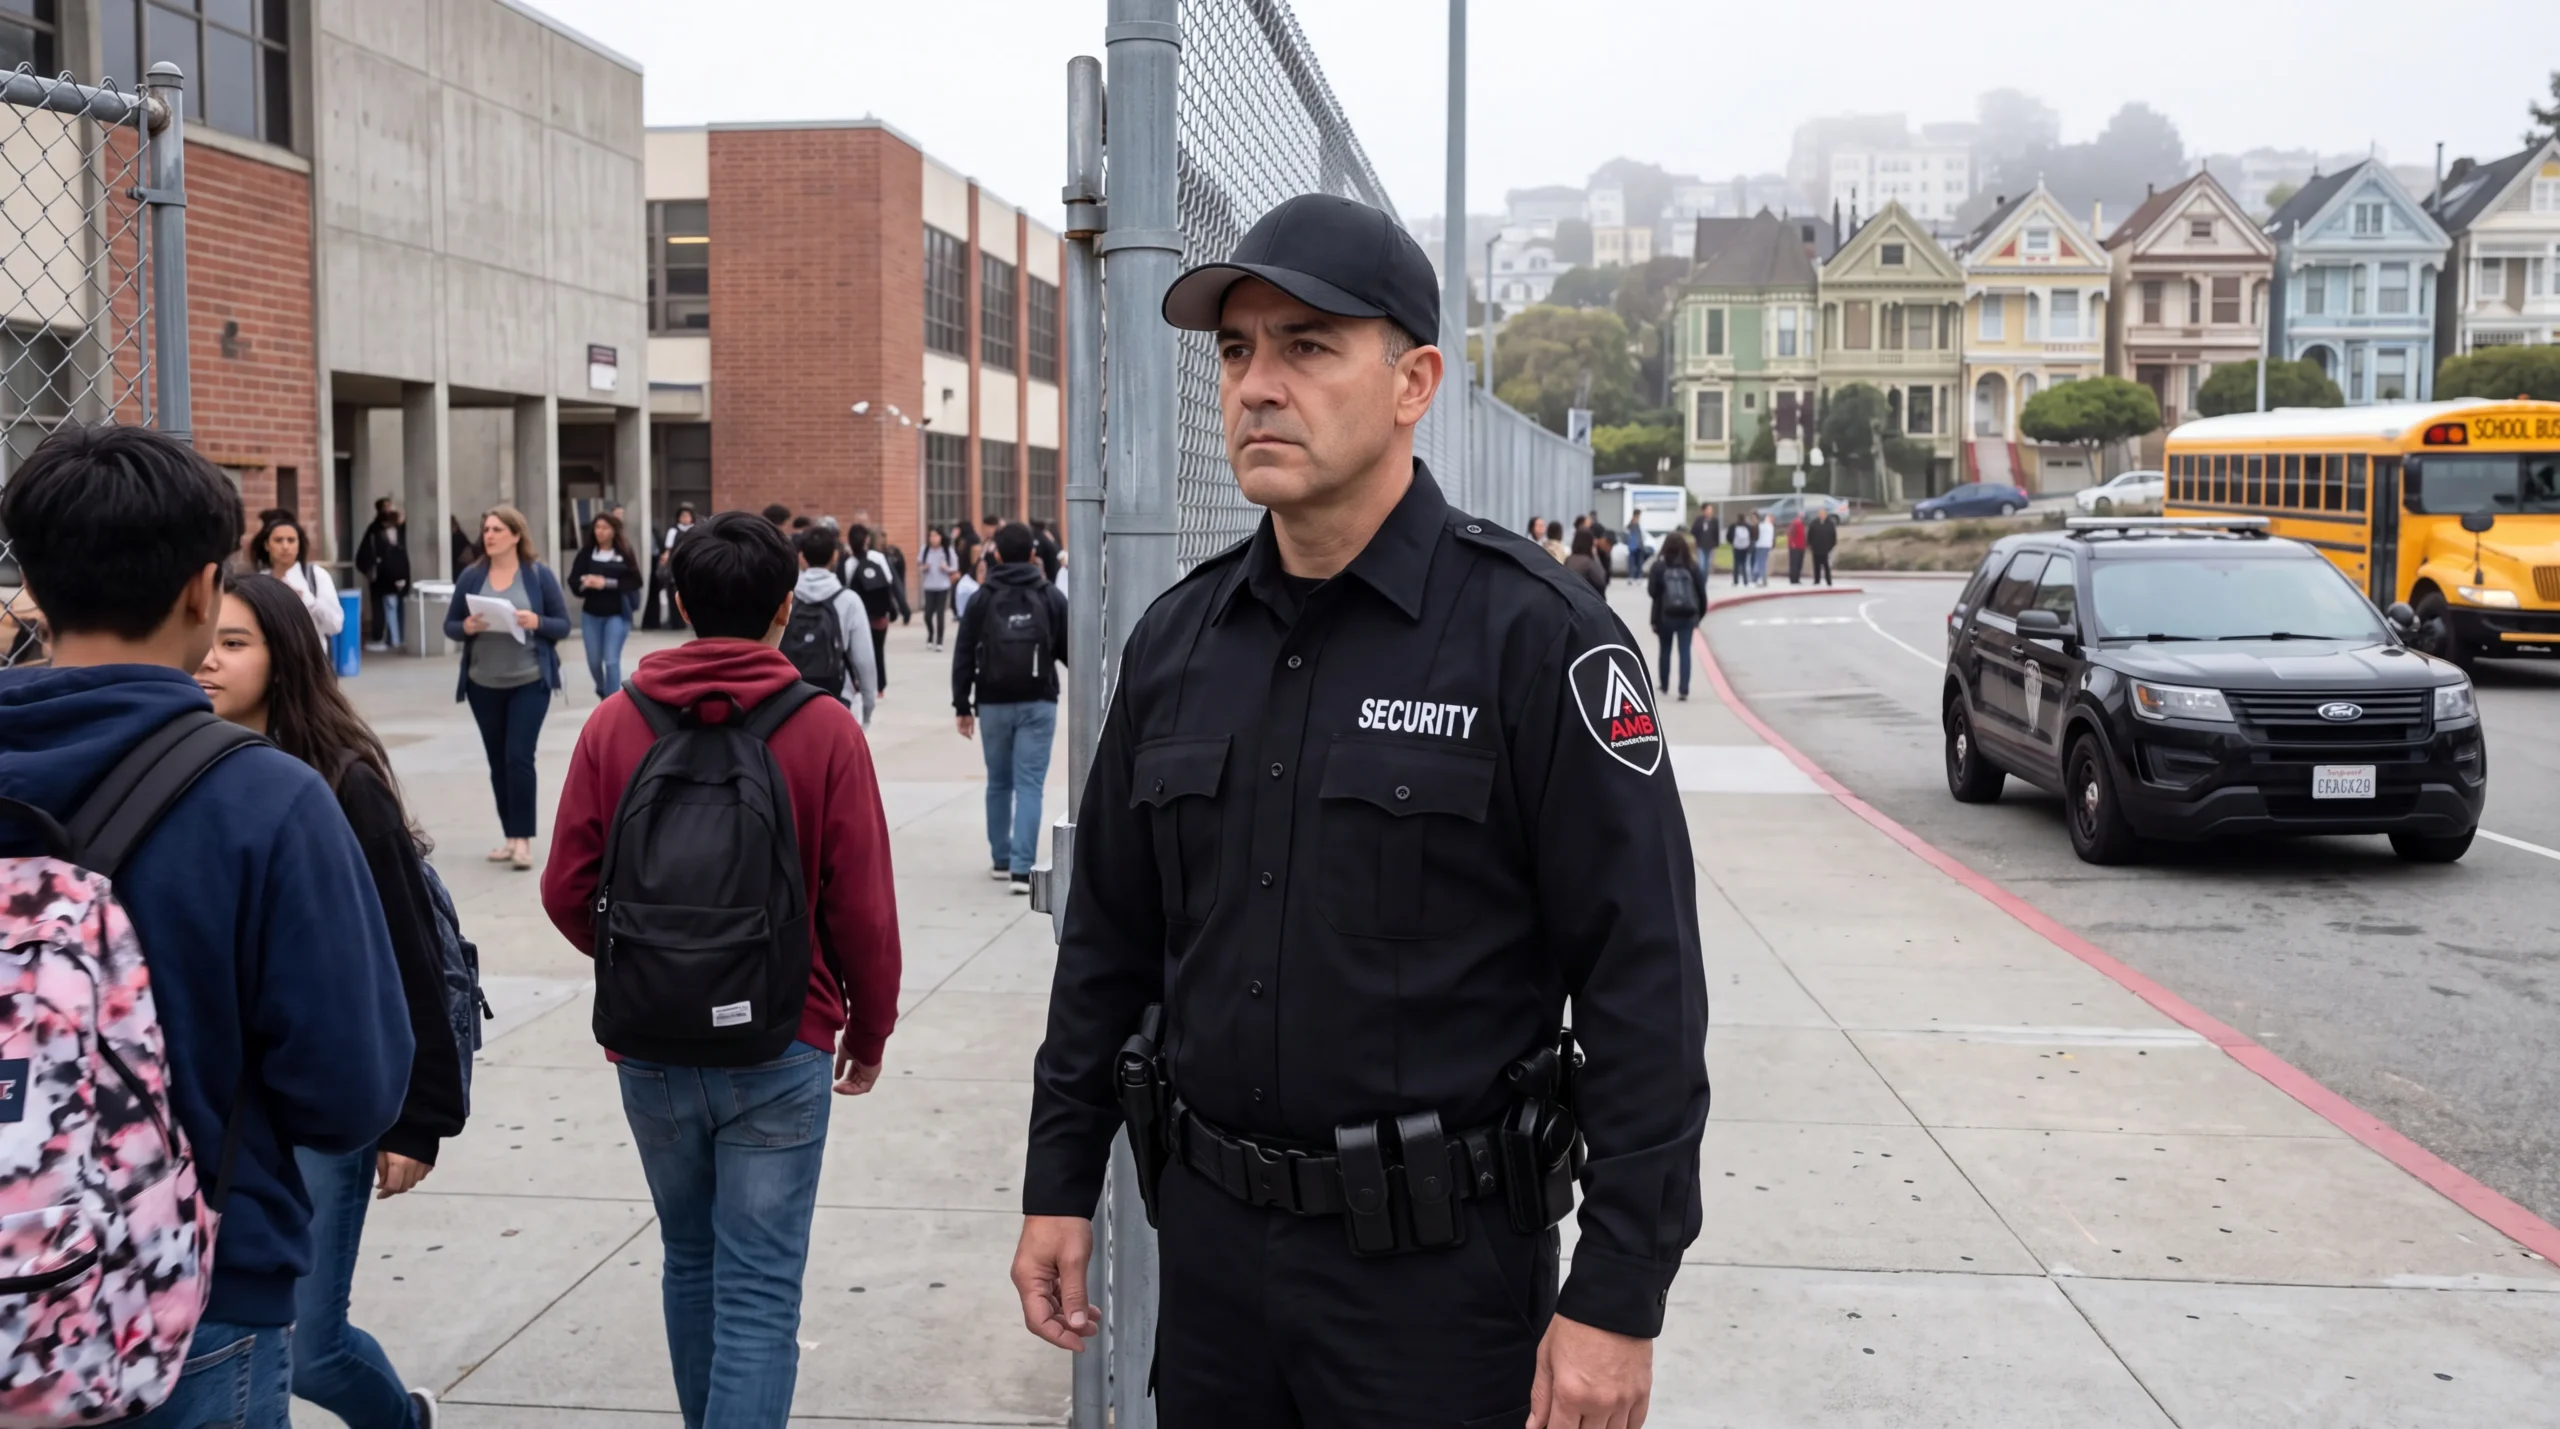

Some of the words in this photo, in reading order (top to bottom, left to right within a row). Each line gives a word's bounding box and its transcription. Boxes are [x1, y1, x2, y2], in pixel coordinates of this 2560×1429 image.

[2474, 418, 2531, 439] SCHOOL
[1358, 698, 1478, 739] SECURITY
[1610, 715, 1654, 741] AMB
